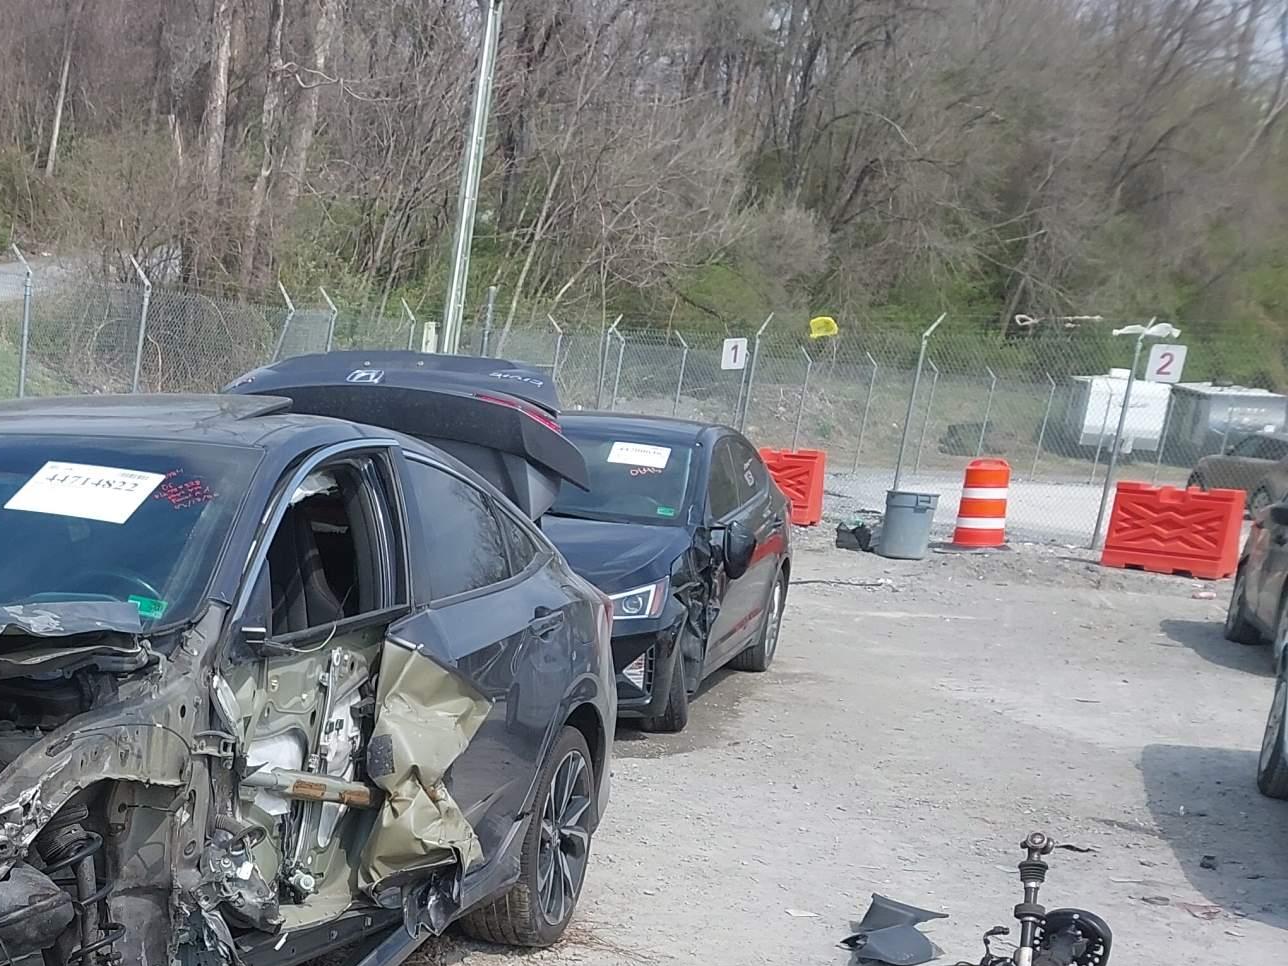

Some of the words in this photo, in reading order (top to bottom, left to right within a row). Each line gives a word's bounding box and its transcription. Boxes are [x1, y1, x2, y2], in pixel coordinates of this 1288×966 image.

[731, 344, 739, 364] 1
[1155, 352, 1174, 375] 2
[46, 473, 139, 492] 44714822
